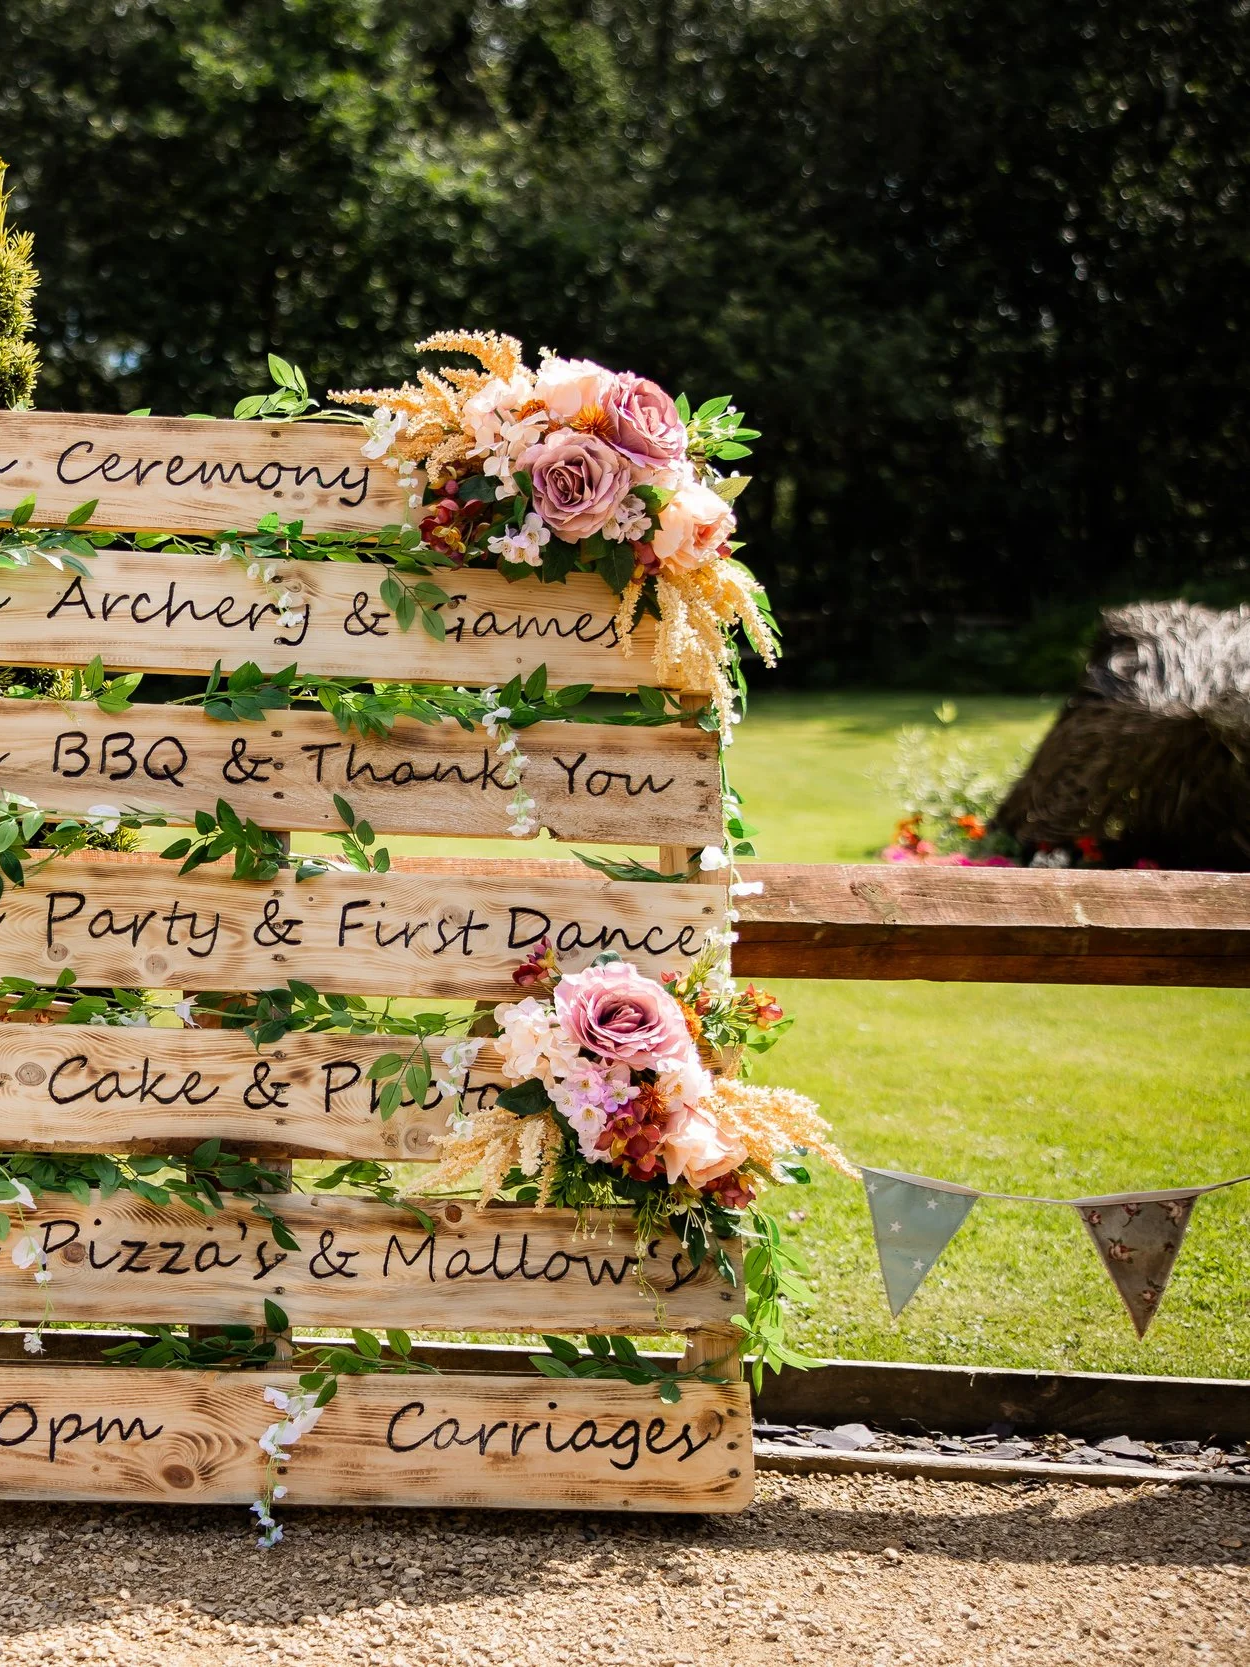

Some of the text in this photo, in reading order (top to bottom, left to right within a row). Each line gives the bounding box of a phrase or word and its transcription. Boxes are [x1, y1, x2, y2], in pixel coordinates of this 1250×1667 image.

[57, 440, 369, 507] Ceremony
[47, 575, 310, 646] Archery
[344, 591, 391, 636] &
[53, 731, 188, 787] BBQ
[223, 737, 274, 784] &
[301, 742, 523, 791] Thank
[553, 752, 674, 797] You
[46, 891, 220, 958] Party
[254, 899, 303, 946] &
[338, 900, 489, 956] First
[507, 907, 710, 957] Dance
[49, 1054, 220, 1106] Cake
[243, 1060, 291, 1110] &
[39, 1218, 288, 1281] Pizza's
[309, 1229, 359, 1280] &
[382, 1231, 701, 1292] Mallow's
[386, 1401, 711, 1471] Carriages
